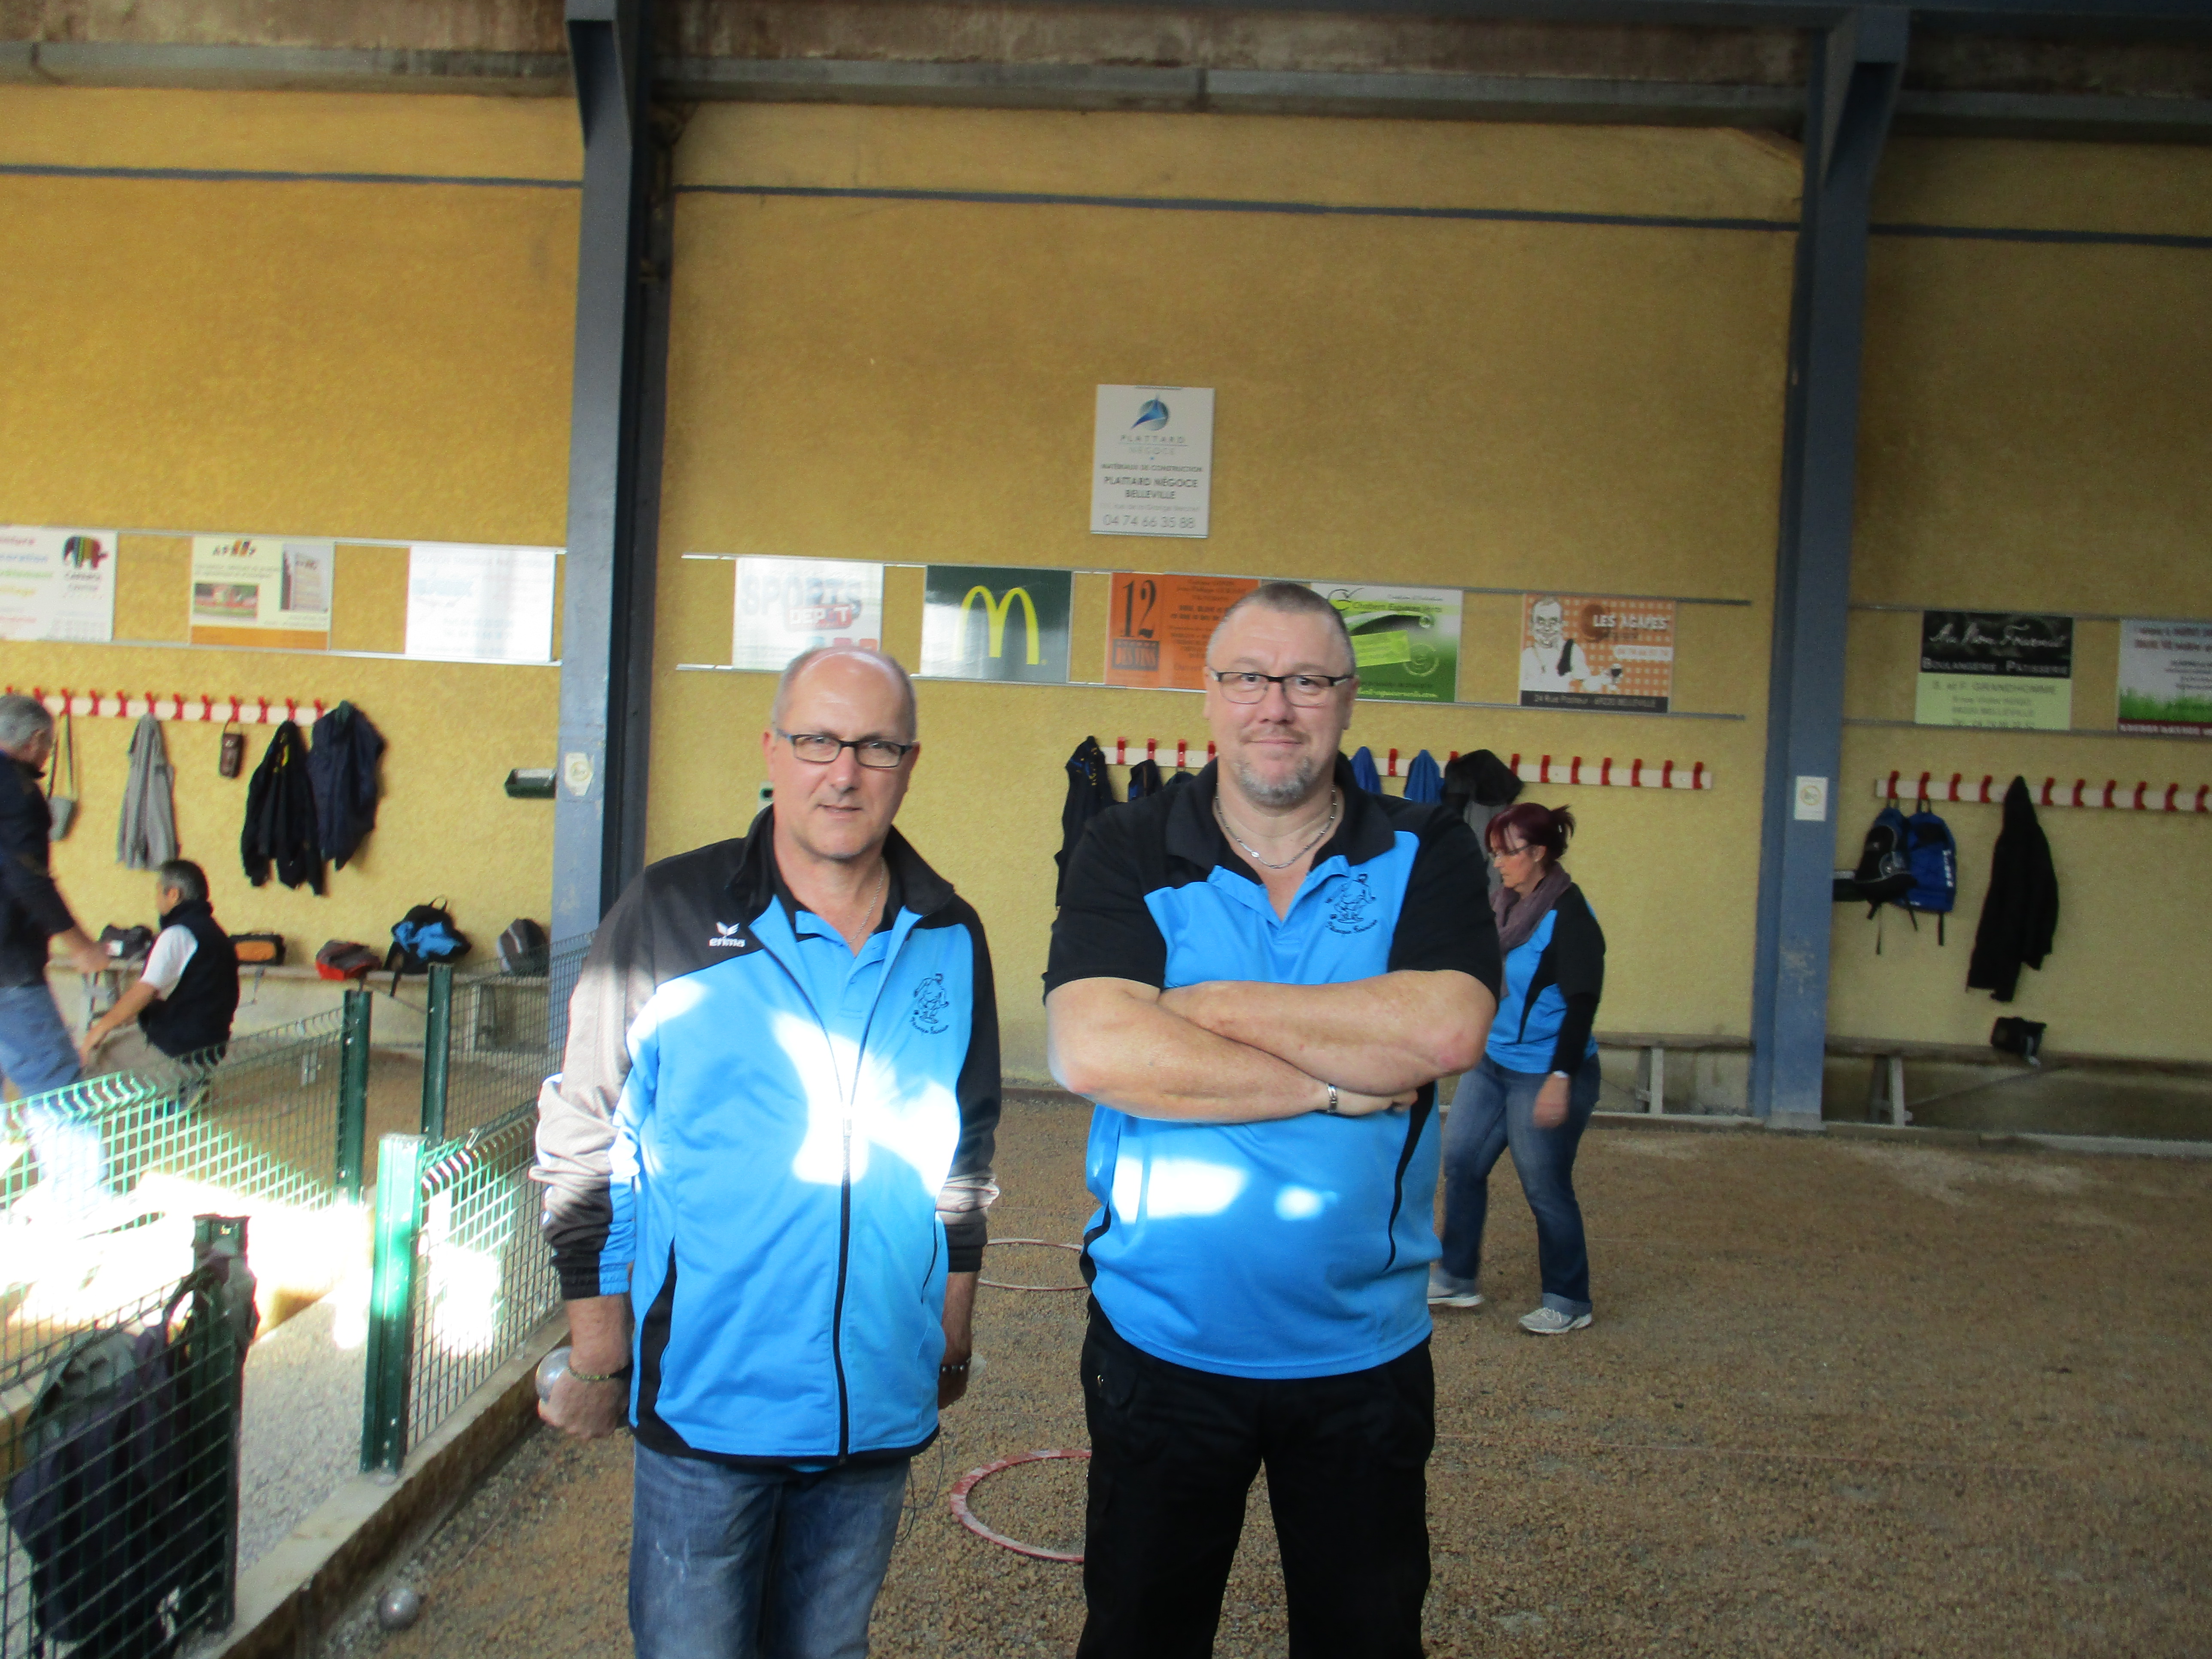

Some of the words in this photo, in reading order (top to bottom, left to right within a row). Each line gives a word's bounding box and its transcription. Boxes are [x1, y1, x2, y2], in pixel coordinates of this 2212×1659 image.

[1104, 476, 1150, 486] PLATTARD
[1125, 489, 1176, 499] BELLEVILLE
[1103, 514, 1118, 526] 04
[1123, 515, 1139, 526] 74
[1142, 516, 1158, 527] 66
[1122, 580, 1157, 639] 12
[1592, 614, 1617, 628] LES
